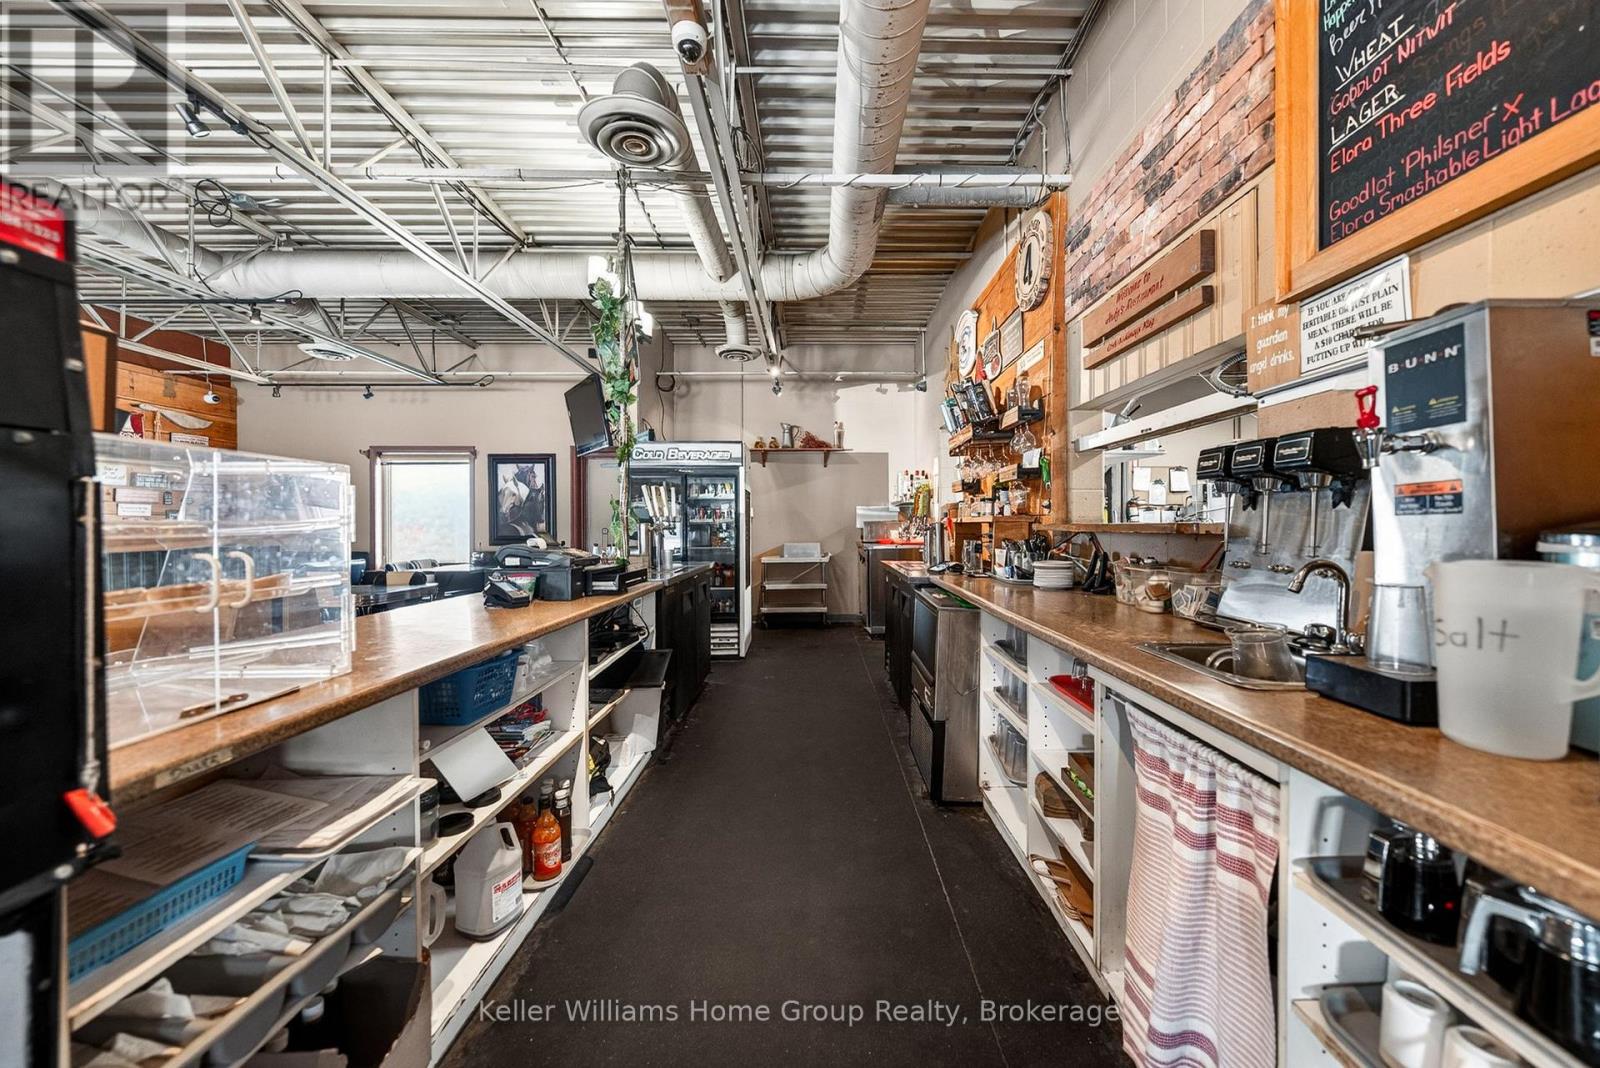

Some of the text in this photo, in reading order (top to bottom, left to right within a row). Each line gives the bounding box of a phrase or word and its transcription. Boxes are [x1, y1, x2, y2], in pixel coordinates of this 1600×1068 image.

[1330, 8, 1367, 56] Beer
[1397, 2, 1457, 64] NITWIT
[1335, 14, 1405, 83] WHEAT
[1331, 40, 1512, 174] Elora Three Fields
[1331, 84, 1399, 145] LAGER
[1330, 209, 1375, 243] Elora
[1379, 150, 1481, 216] Smashable
[1483, 107, 1544, 160] Light
[1329, 166, 1397, 221] Goodlot
[1143, 272, 1152, 285] to
[1371, 283, 1400, 304] PLAIN
[1257, 307, 1275, 326] think
[1277, 303, 1290, 319] my
[1307, 305, 1315, 317] IF
[1331, 315, 1357, 331] THERE
[1358, 306, 1381, 320] WILL
[1381, 300, 1394, 311] BE
[1256, 329, 1289, 354] guardian
[1306, 348, 1339, 364] PUTTING
[1340, 343, 1351, 354] UP
[1314, 341, 1321, 350] A
[1249, 356, 1268, 375] angel
[1435, 616, 1521, 653] Salt
